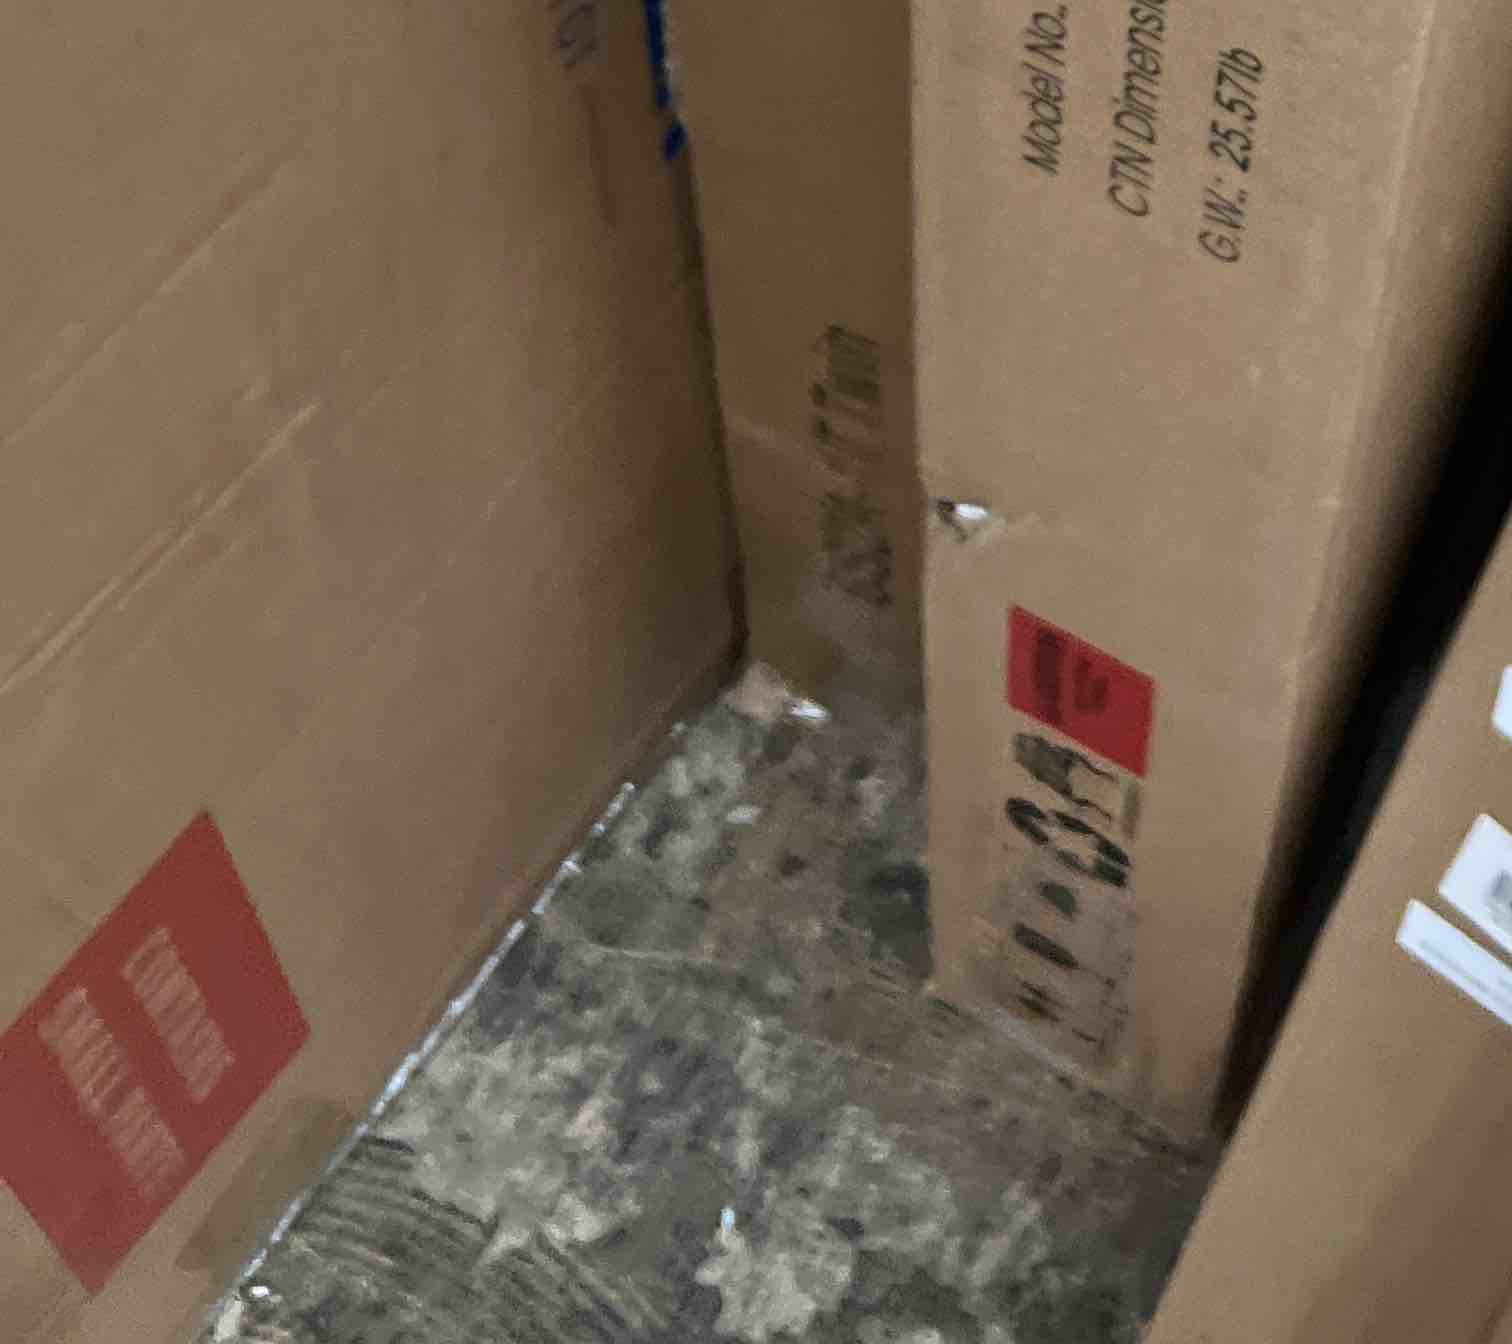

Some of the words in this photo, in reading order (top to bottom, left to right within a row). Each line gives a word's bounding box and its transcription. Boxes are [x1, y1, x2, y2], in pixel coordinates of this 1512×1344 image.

[1021, 62, 1064, 175] Model
[1209, 47, 1265, 173] 25.57lb
[1108, 142, 1153, 218] CTN
[1198, 176, 1246, 264] G.W.:
